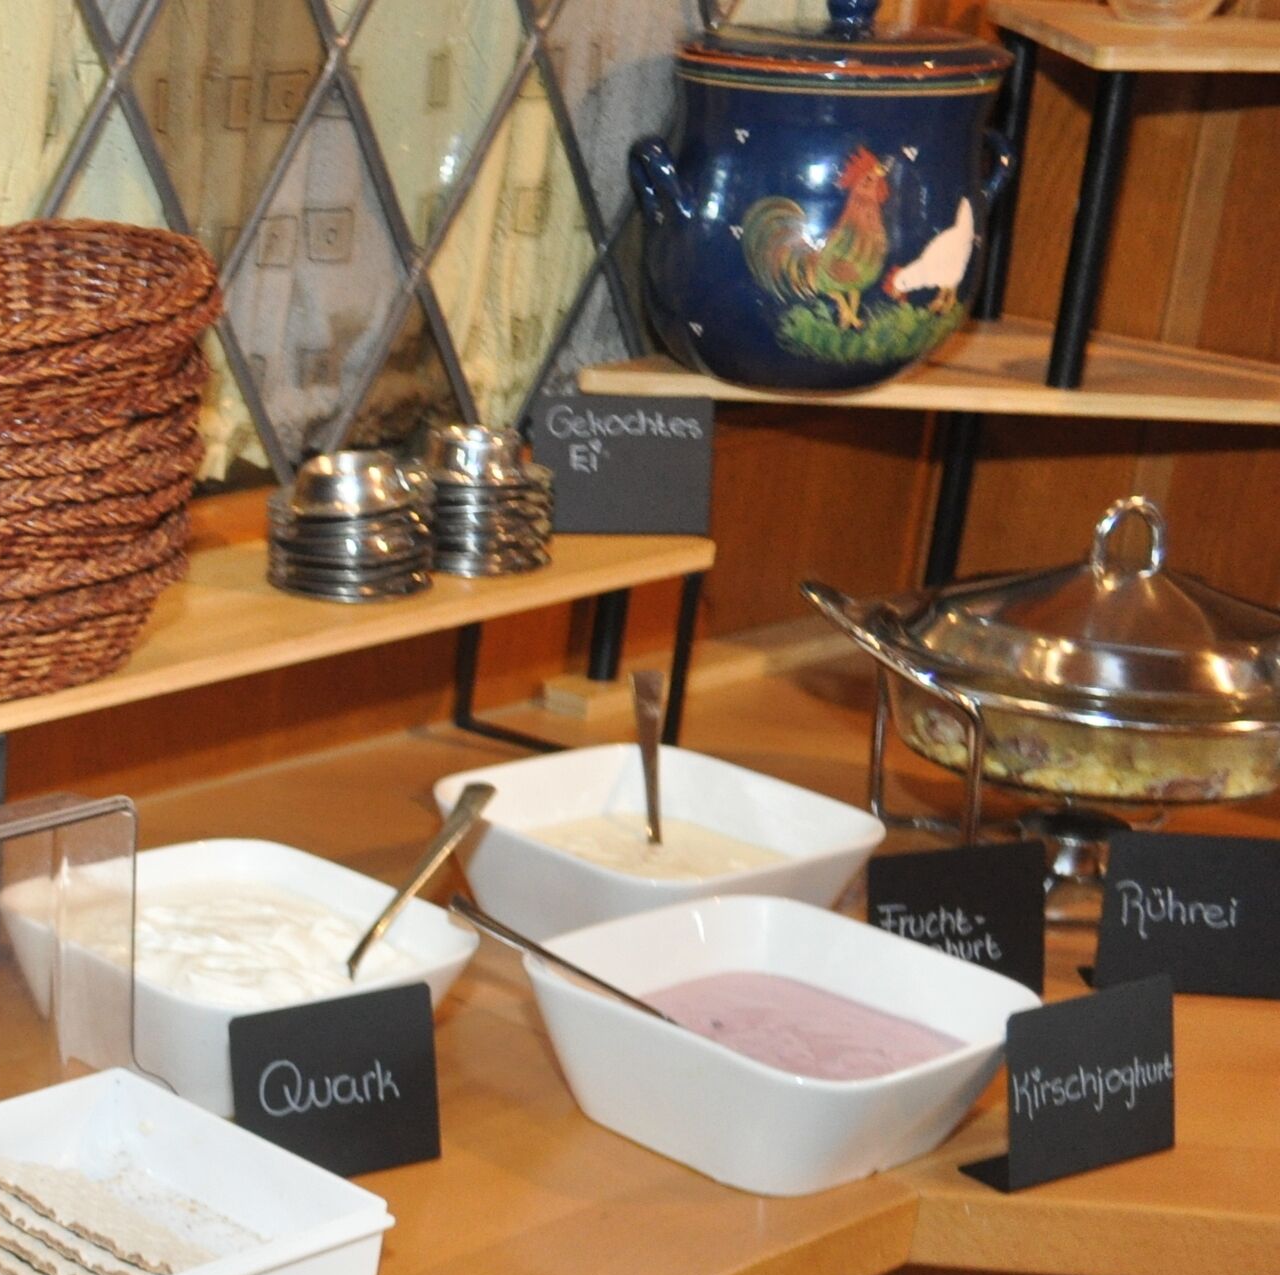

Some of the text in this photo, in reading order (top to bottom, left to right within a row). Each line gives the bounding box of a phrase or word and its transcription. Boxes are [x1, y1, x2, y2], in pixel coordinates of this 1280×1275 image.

[568, 438, 604, 474] Ei
[1116, 880, 1239, 940] Rührei
[930, 932, 1002, 961] hurt
[258, 1058, 401, 1117] Quark
[1011, 1053, 1175, 1121] Kirschjoghurt
